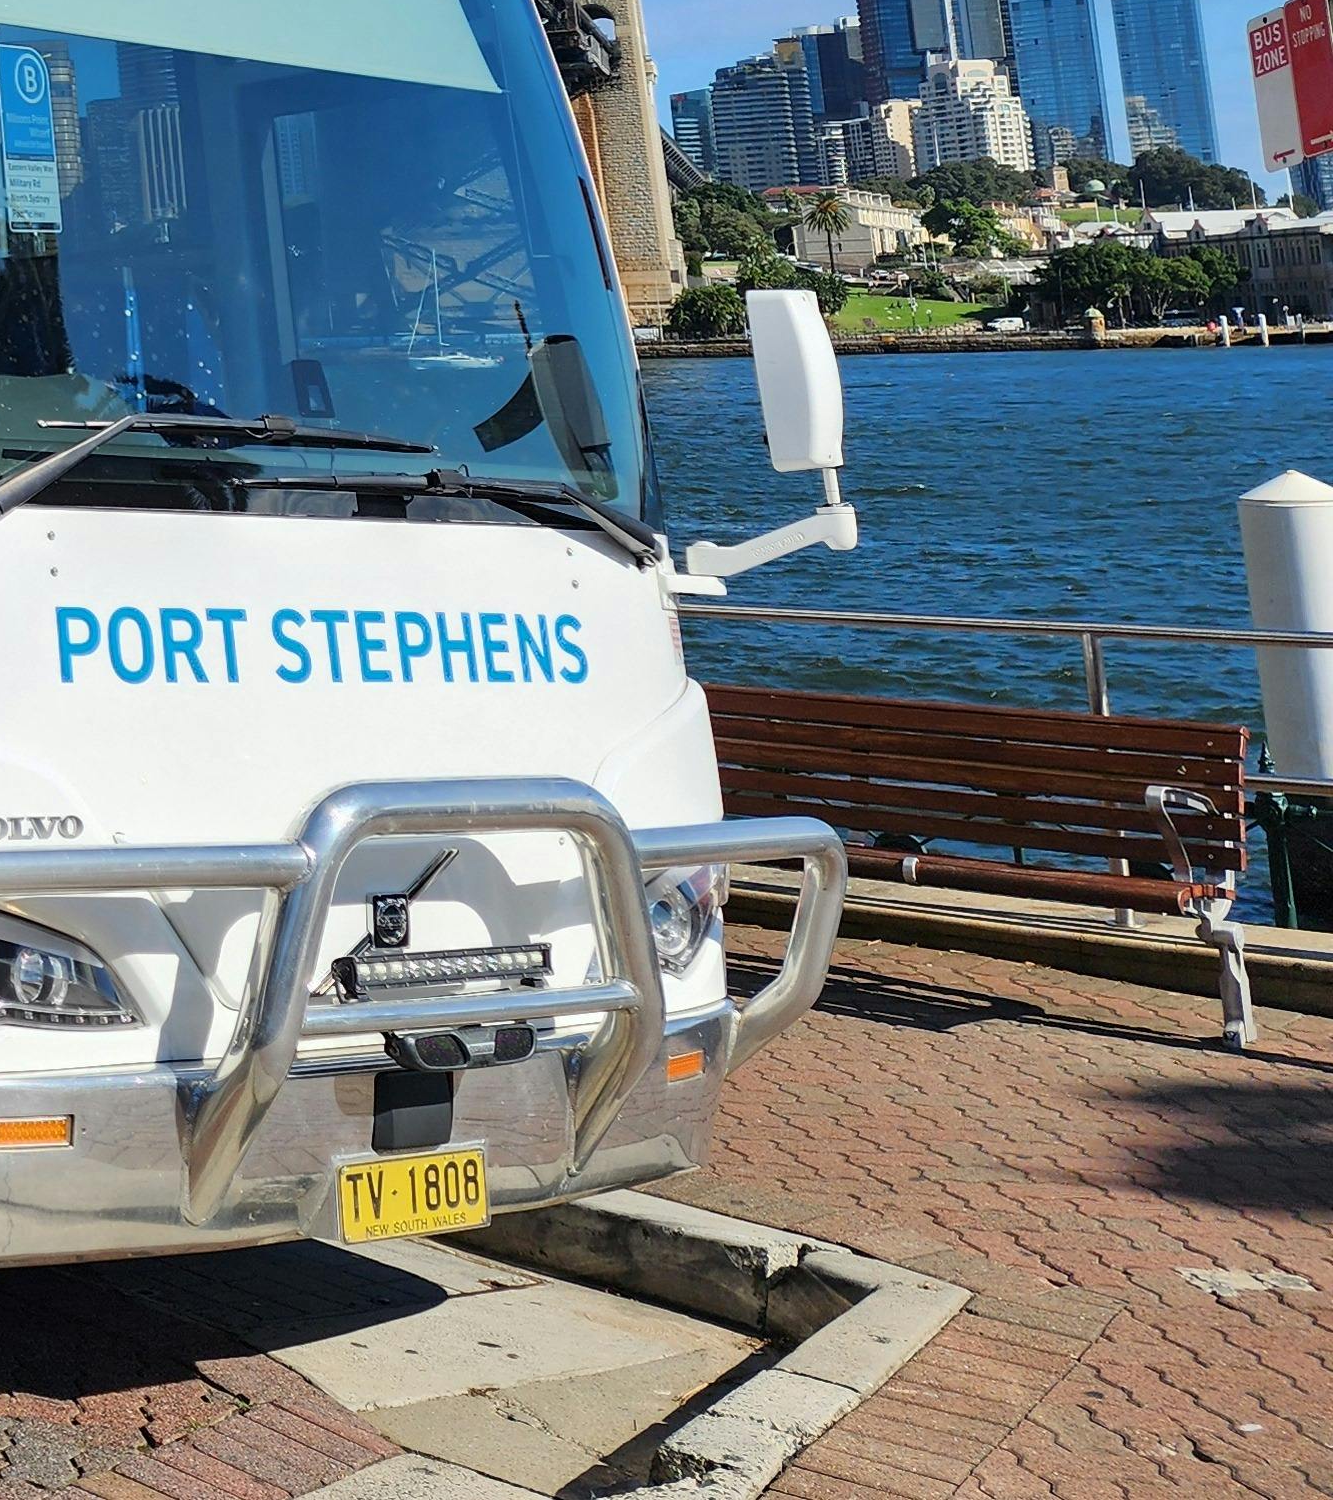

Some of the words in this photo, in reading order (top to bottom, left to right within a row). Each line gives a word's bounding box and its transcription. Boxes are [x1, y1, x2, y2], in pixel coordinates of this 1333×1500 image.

[1299, 4, 1312, 22] NO
[1253, 23, 1281, 51] BUS
[1292, 22, 1326, 48] STOPPING
[1255, 45, 1287, 75] ZONE
[23, 65, 37, 93] B
[55, 605, 247, 683] PORT
[273, 608, 589, 683] STEPHENS
[409, 1158, 480, 1214] 1808
[366, 1225, 389, 1237] NEW
[394, 1219, 428, 1234] SOUTH
[433, 1212, 466, 1227] WALES
